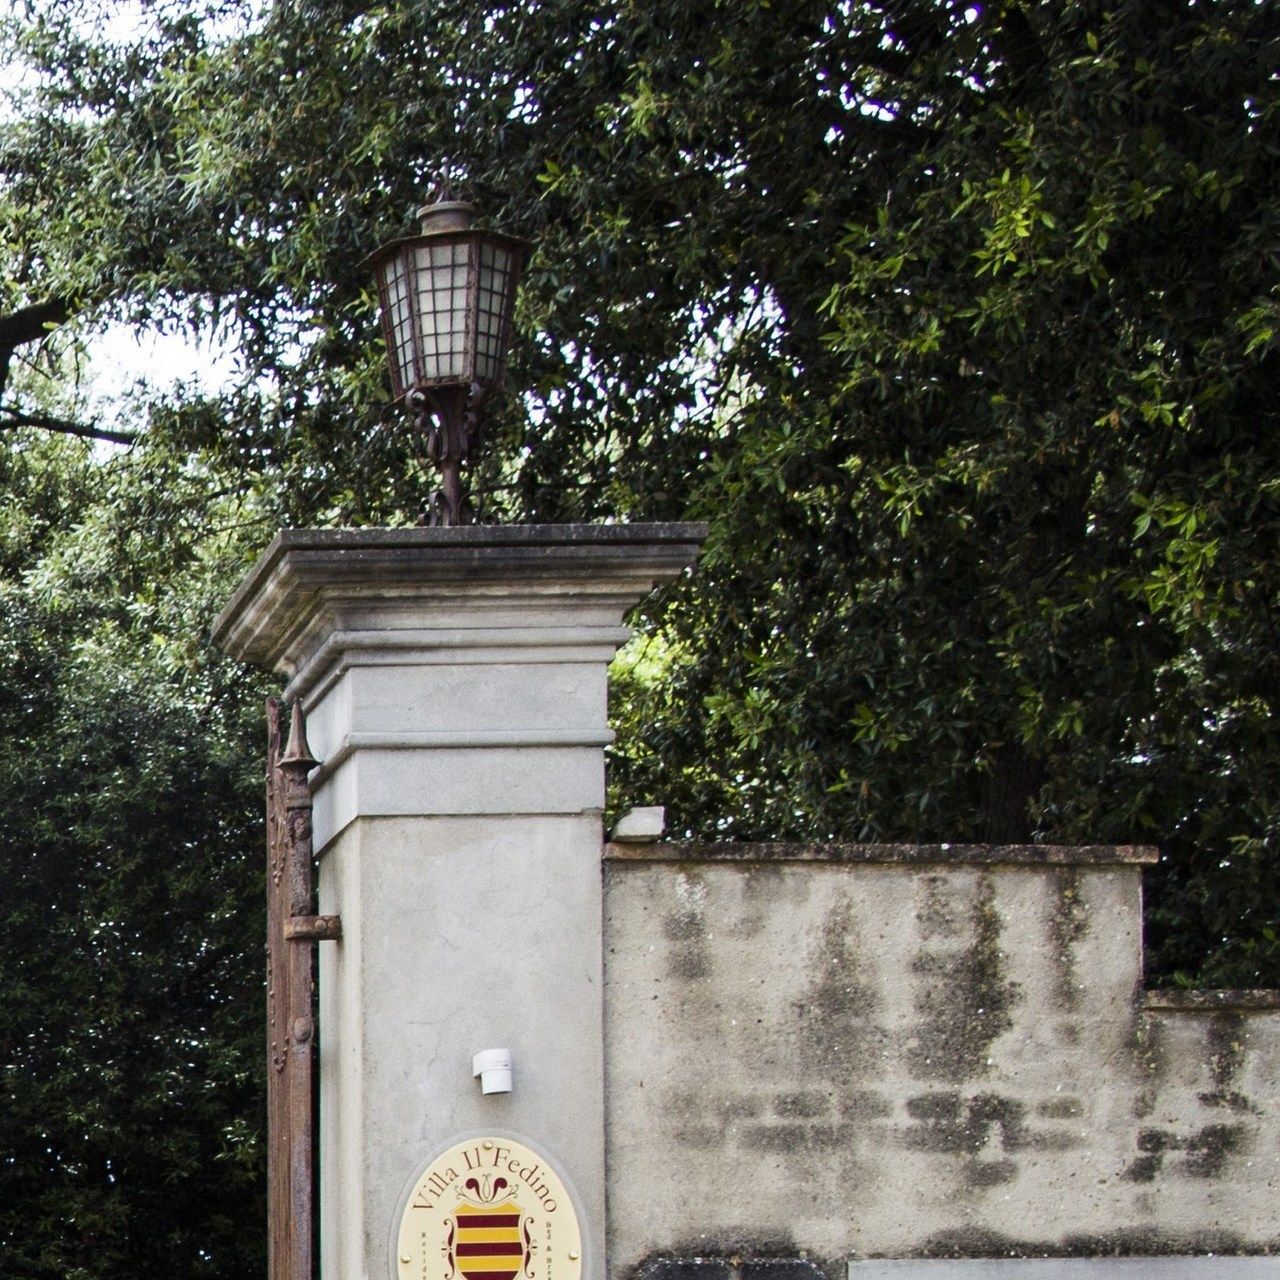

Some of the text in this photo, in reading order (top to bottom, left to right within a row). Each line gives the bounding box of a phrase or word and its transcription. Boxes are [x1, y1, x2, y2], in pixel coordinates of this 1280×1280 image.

[412, 1147, 558, 1214] Villa Il Fedino
